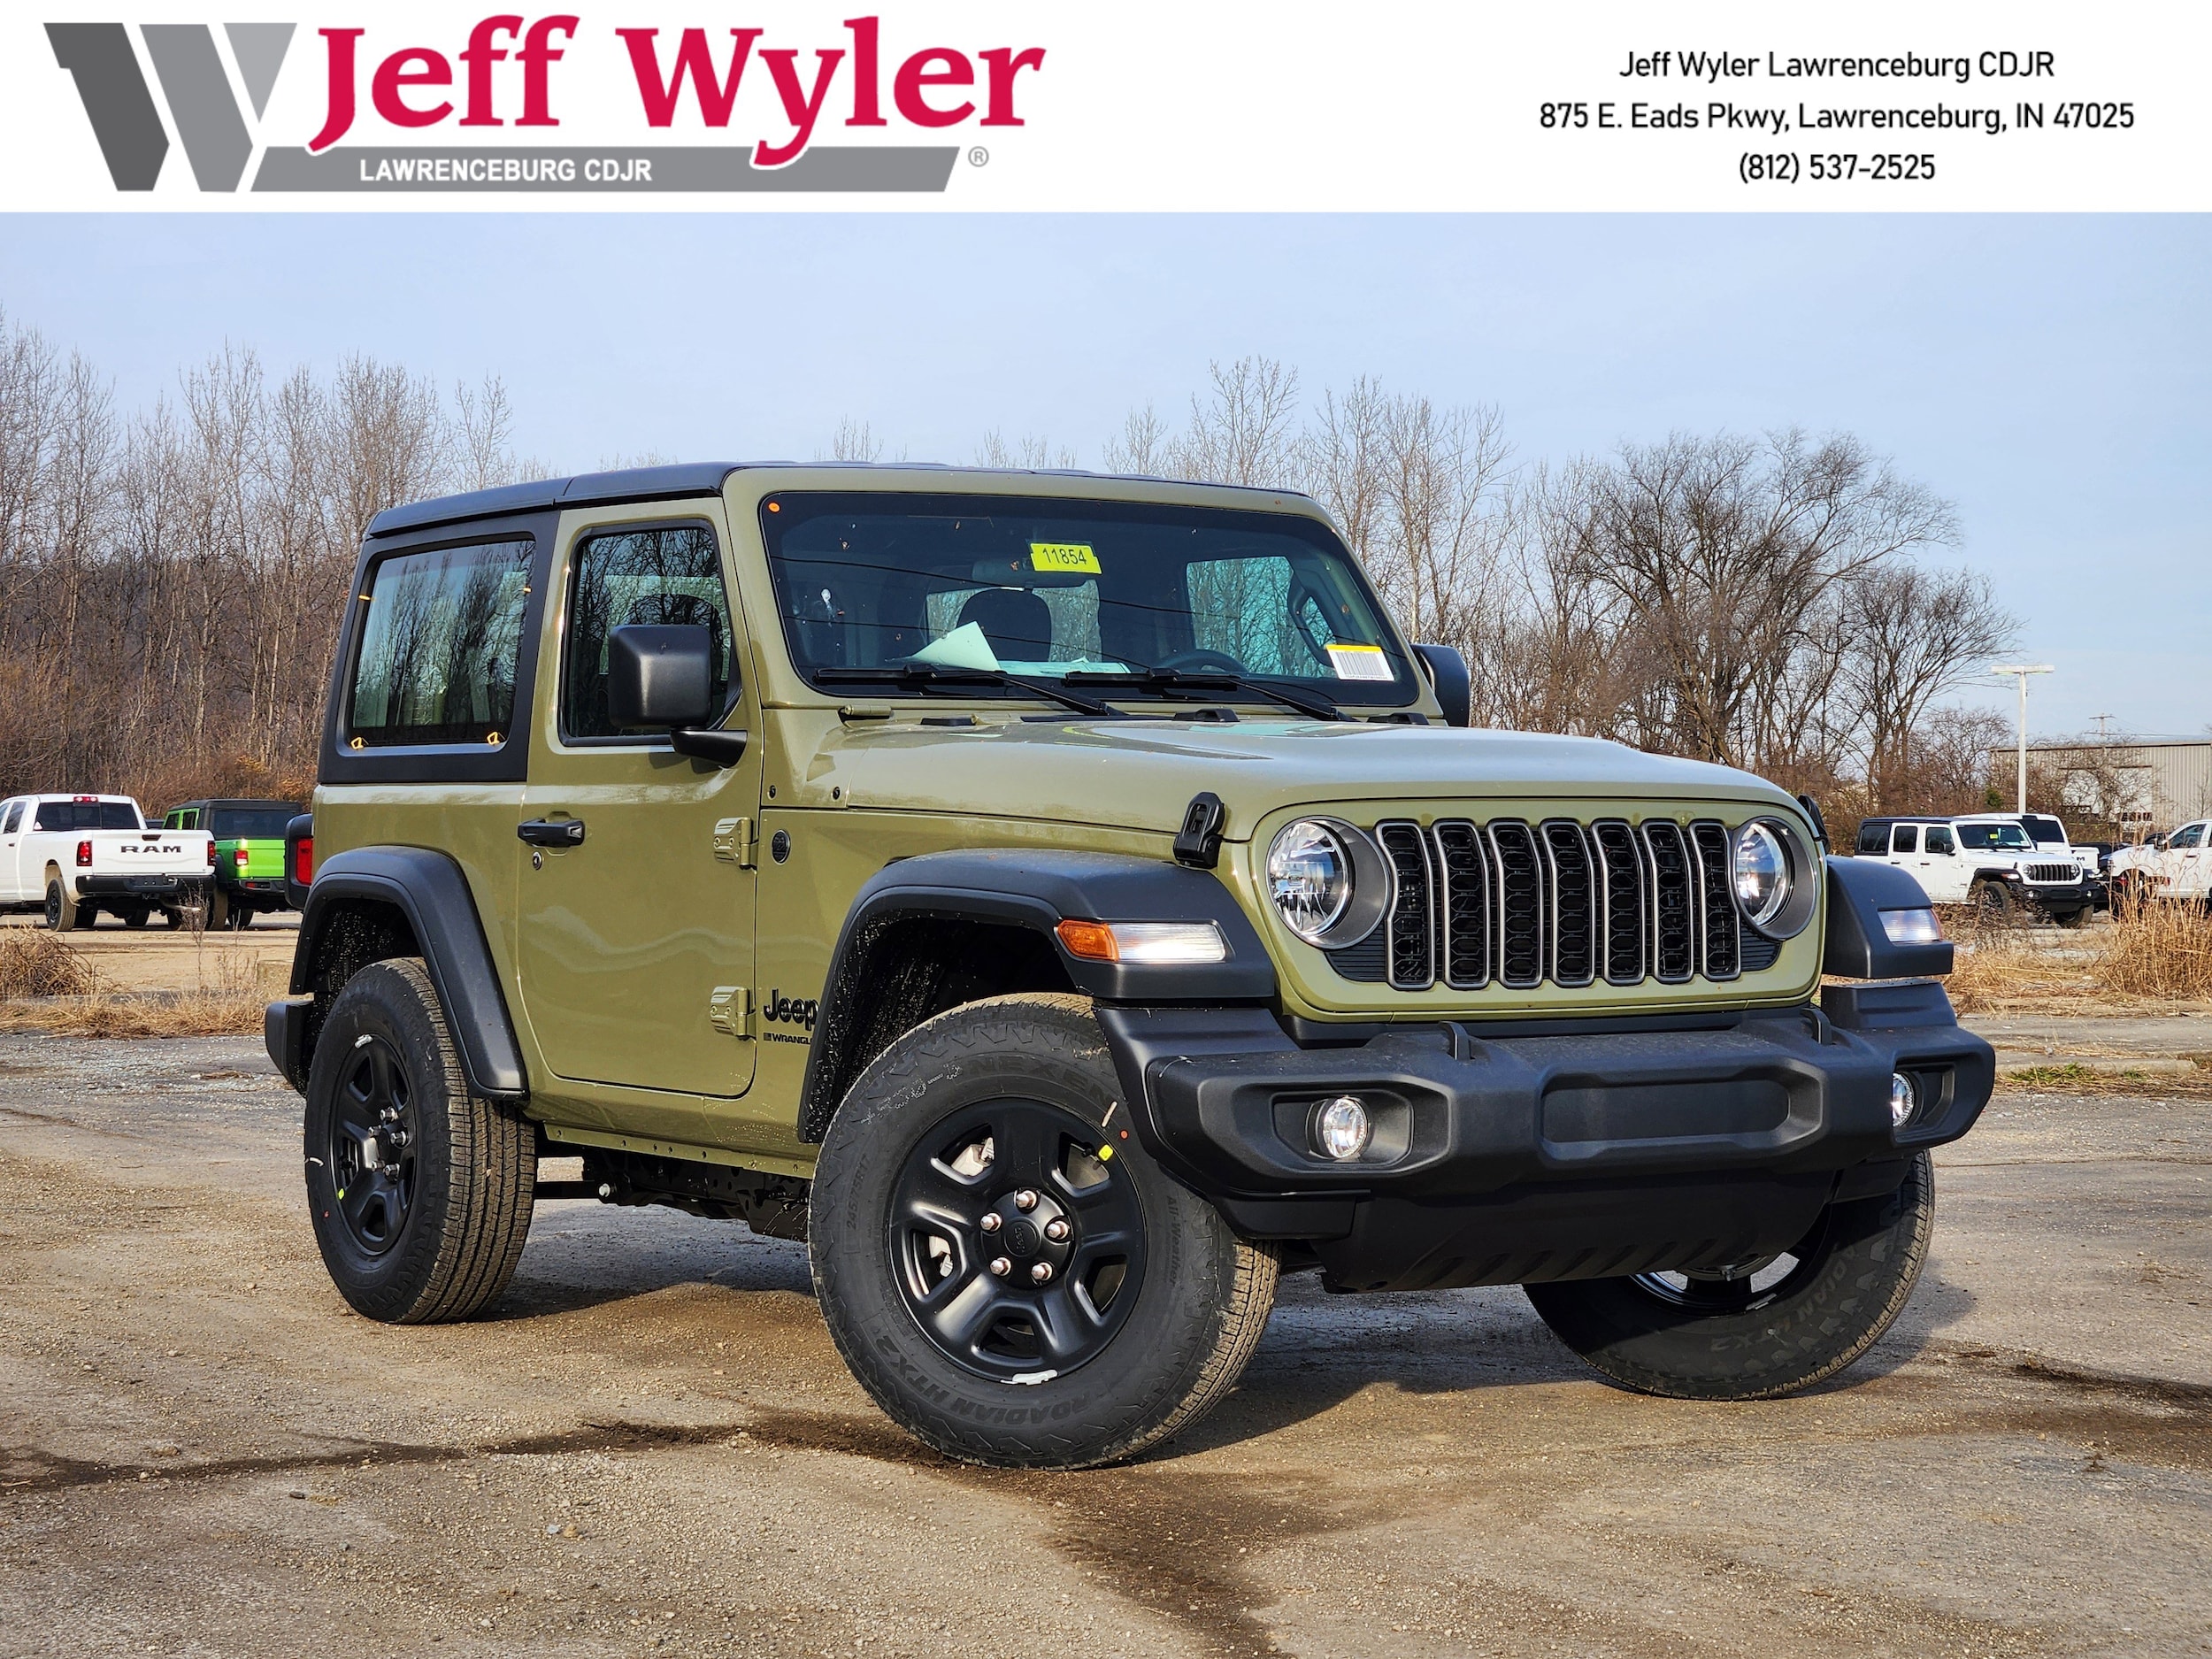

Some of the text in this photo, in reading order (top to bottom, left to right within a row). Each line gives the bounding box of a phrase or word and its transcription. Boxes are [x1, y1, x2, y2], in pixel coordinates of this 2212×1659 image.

[1042, 547, 1087, 565] 11854
[120, 845, 182, 854] RAM
[763, 988, 821, 1031] Jeep
[1166, 1194, 1184, 1286] All-Weather
[949, 1394, 1092, 1425] ROADIAN
